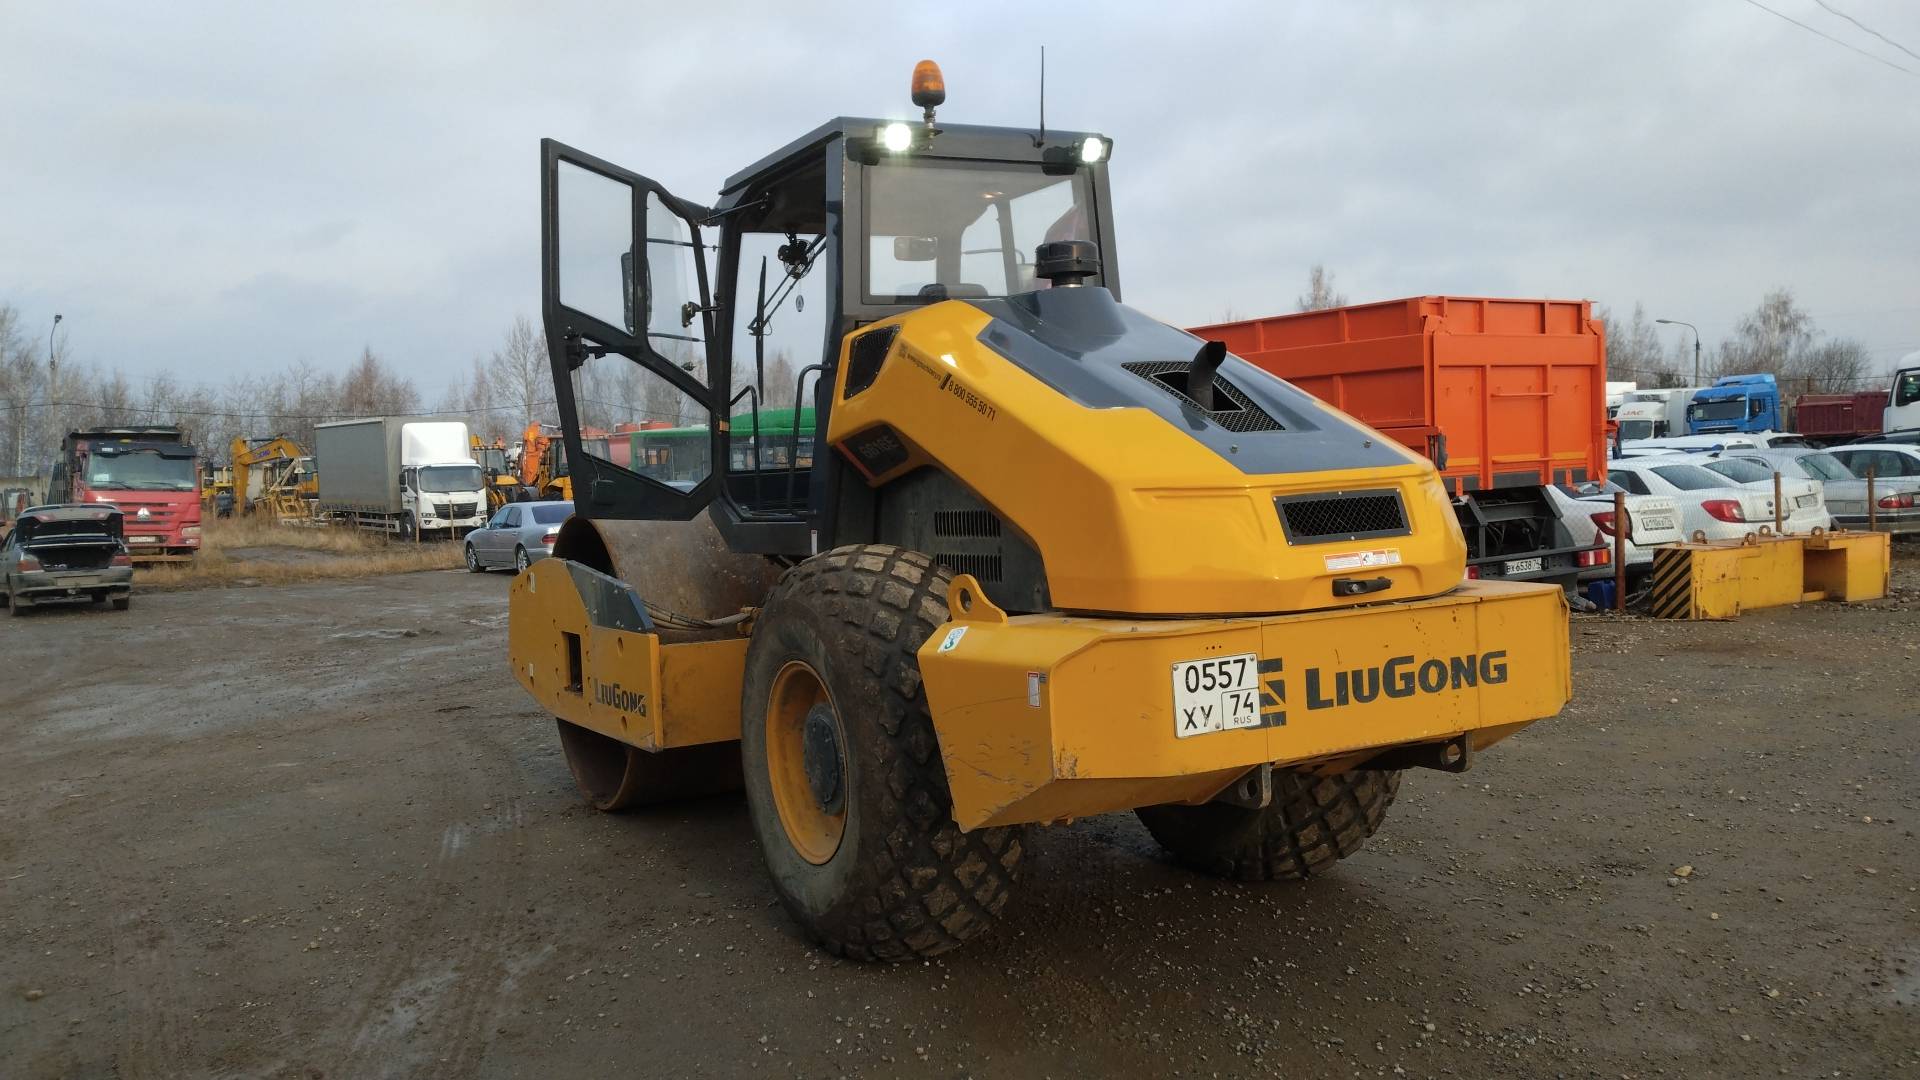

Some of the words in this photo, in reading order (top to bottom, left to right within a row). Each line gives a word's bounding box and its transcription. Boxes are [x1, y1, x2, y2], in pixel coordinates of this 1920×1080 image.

[948, 380, 954, 392] 8
[953, 383, 966, 401] 800
[965, 392, 978, 409] 555
[977, 400, 987, 415] 50
[987, 405, 996, 421] 71
[1185, 658, 1247, 693] 0557
[1229, 692, 1254, 716] 74
[1233, 716, 1252, 725] RUS
